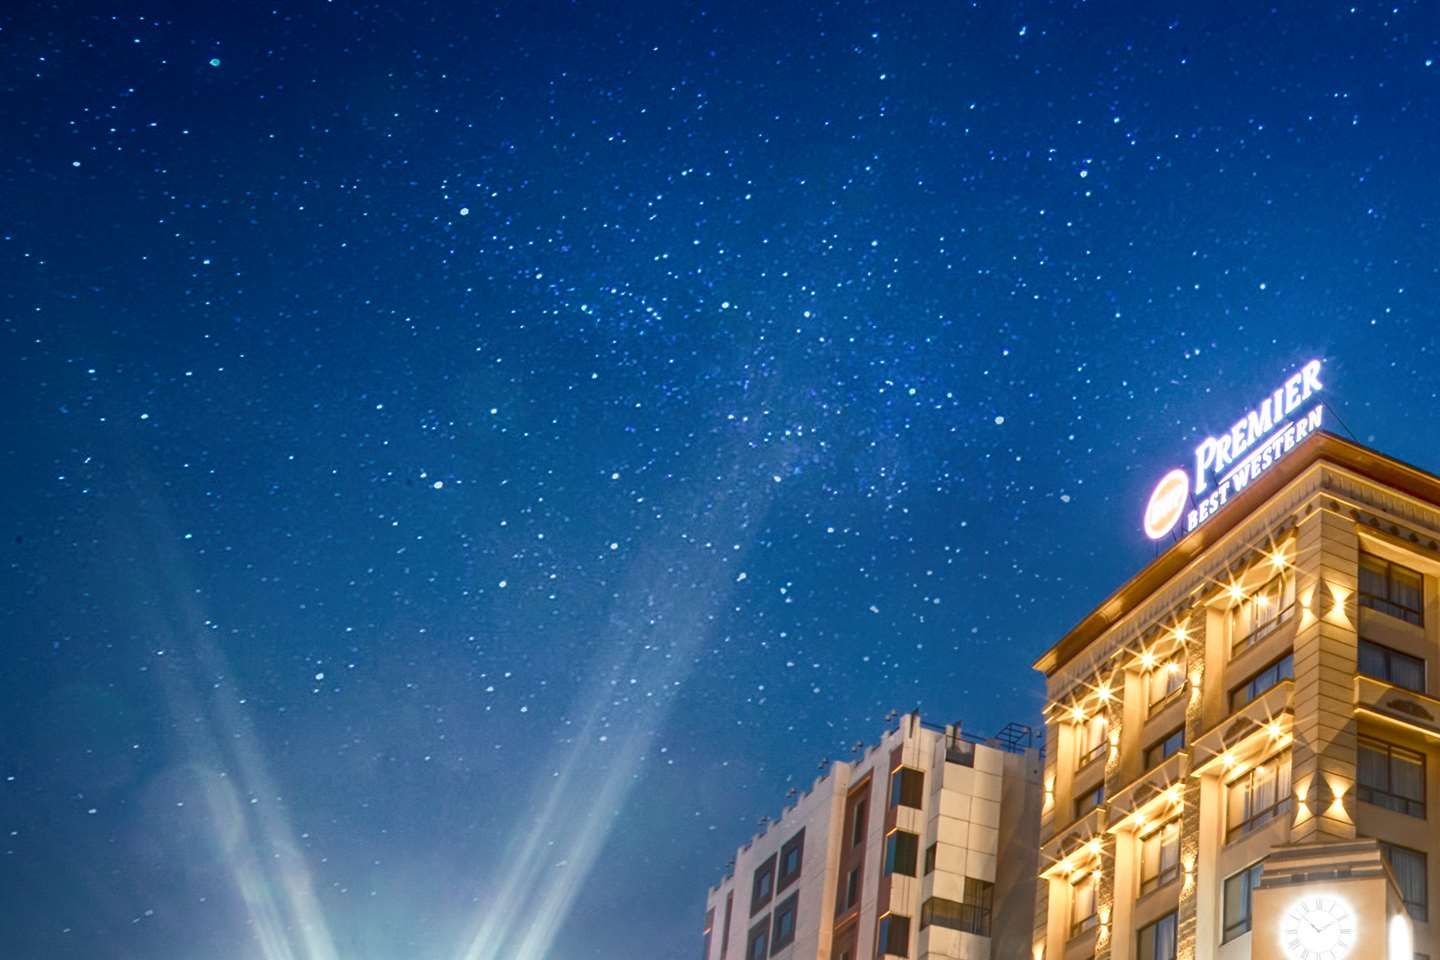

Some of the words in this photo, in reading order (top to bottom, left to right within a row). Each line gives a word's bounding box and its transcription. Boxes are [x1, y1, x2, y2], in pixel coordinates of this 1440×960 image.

[1188, 482, 1230, 531] BEST
[1233, 405, 1323, 492] WESTERN
[1195, 360, 1322, 494] PREMIER
